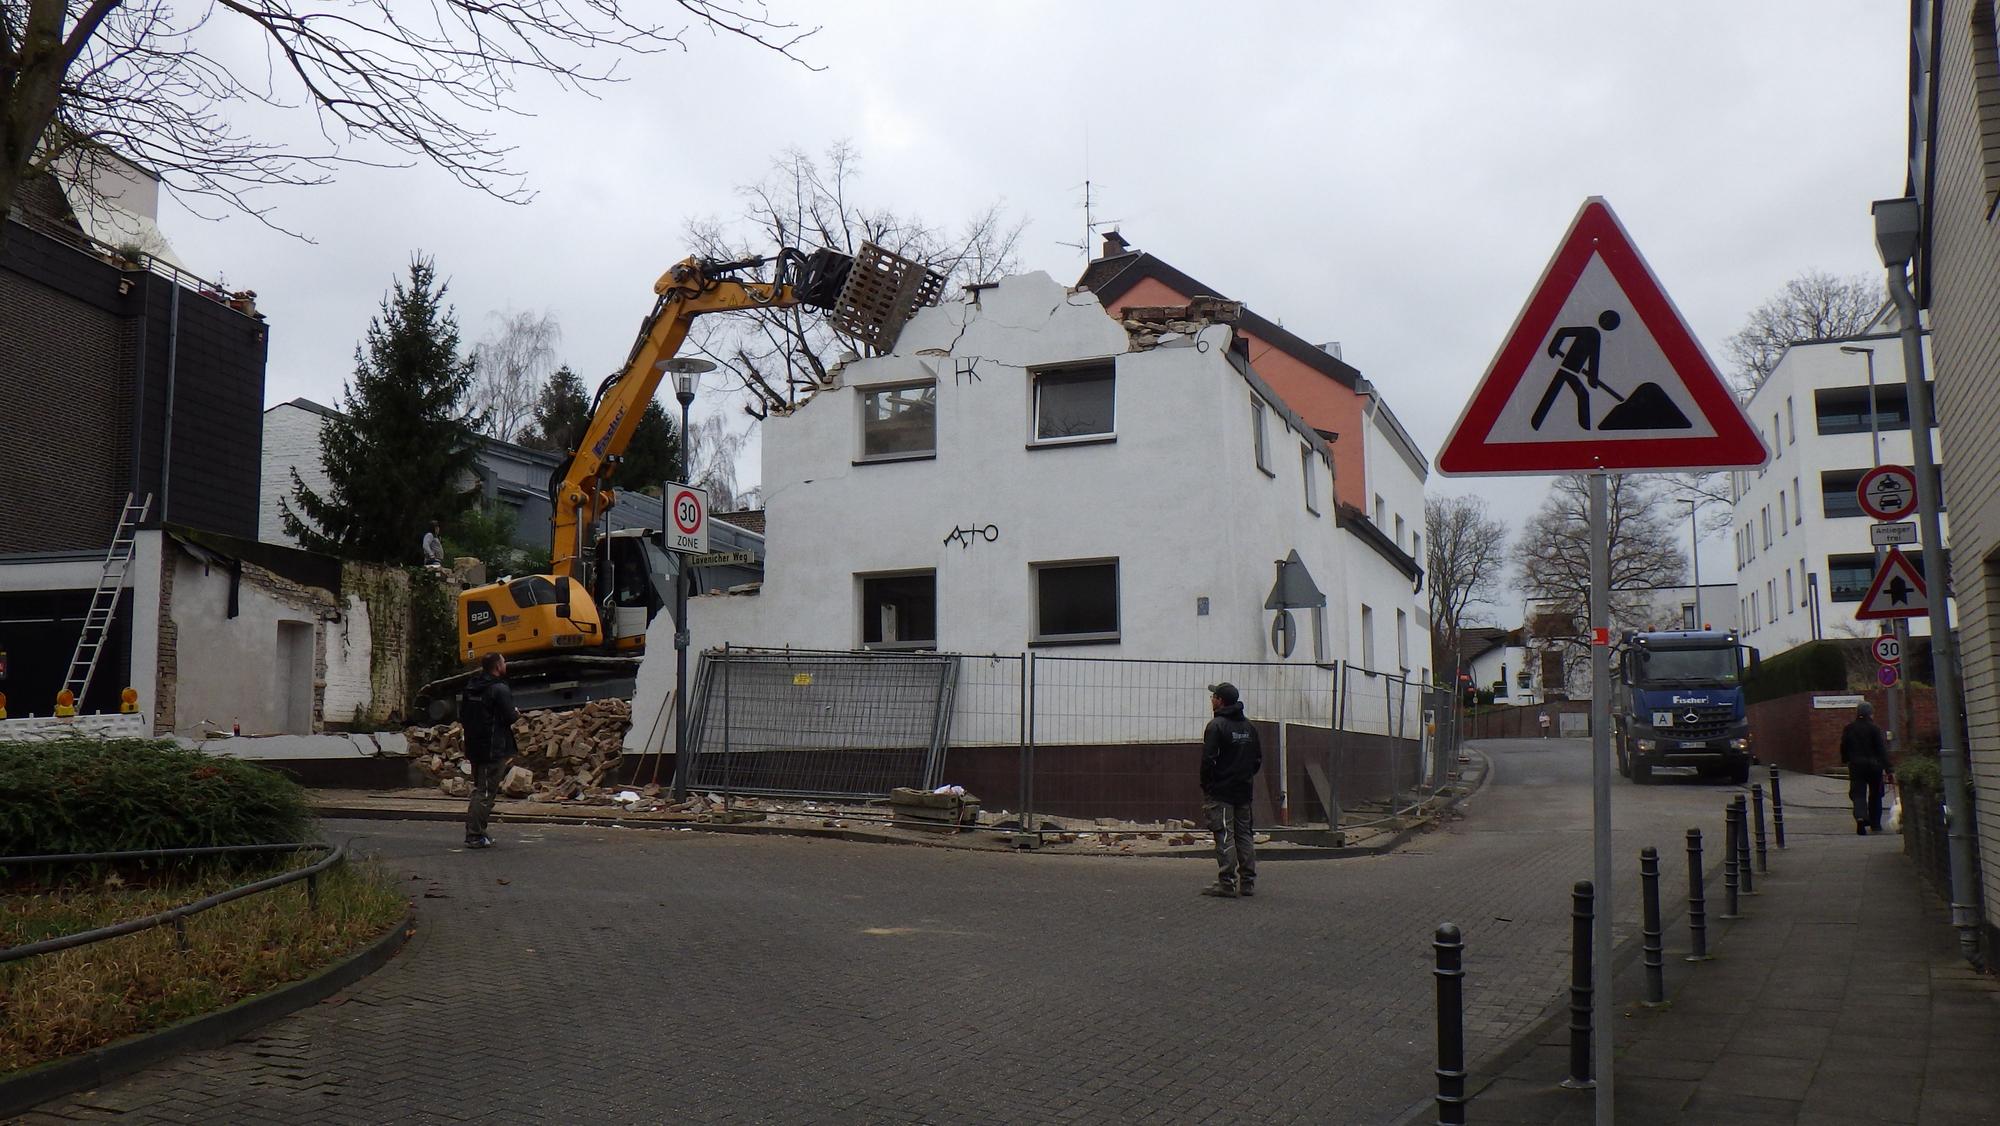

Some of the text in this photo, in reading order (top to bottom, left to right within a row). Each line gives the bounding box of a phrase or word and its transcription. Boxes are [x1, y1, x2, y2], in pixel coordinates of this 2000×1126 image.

[679, 502, 696, 523] 30
[677, 535, 699, 549] ZONE
[732, 552, 748, 563] Weg
[471, 611, 489, 622] 920
[1879, 642, 1900, 656] 30
[1672, 695, 1708, 704] Fischer
[1658, 714, 1669, 725] A
